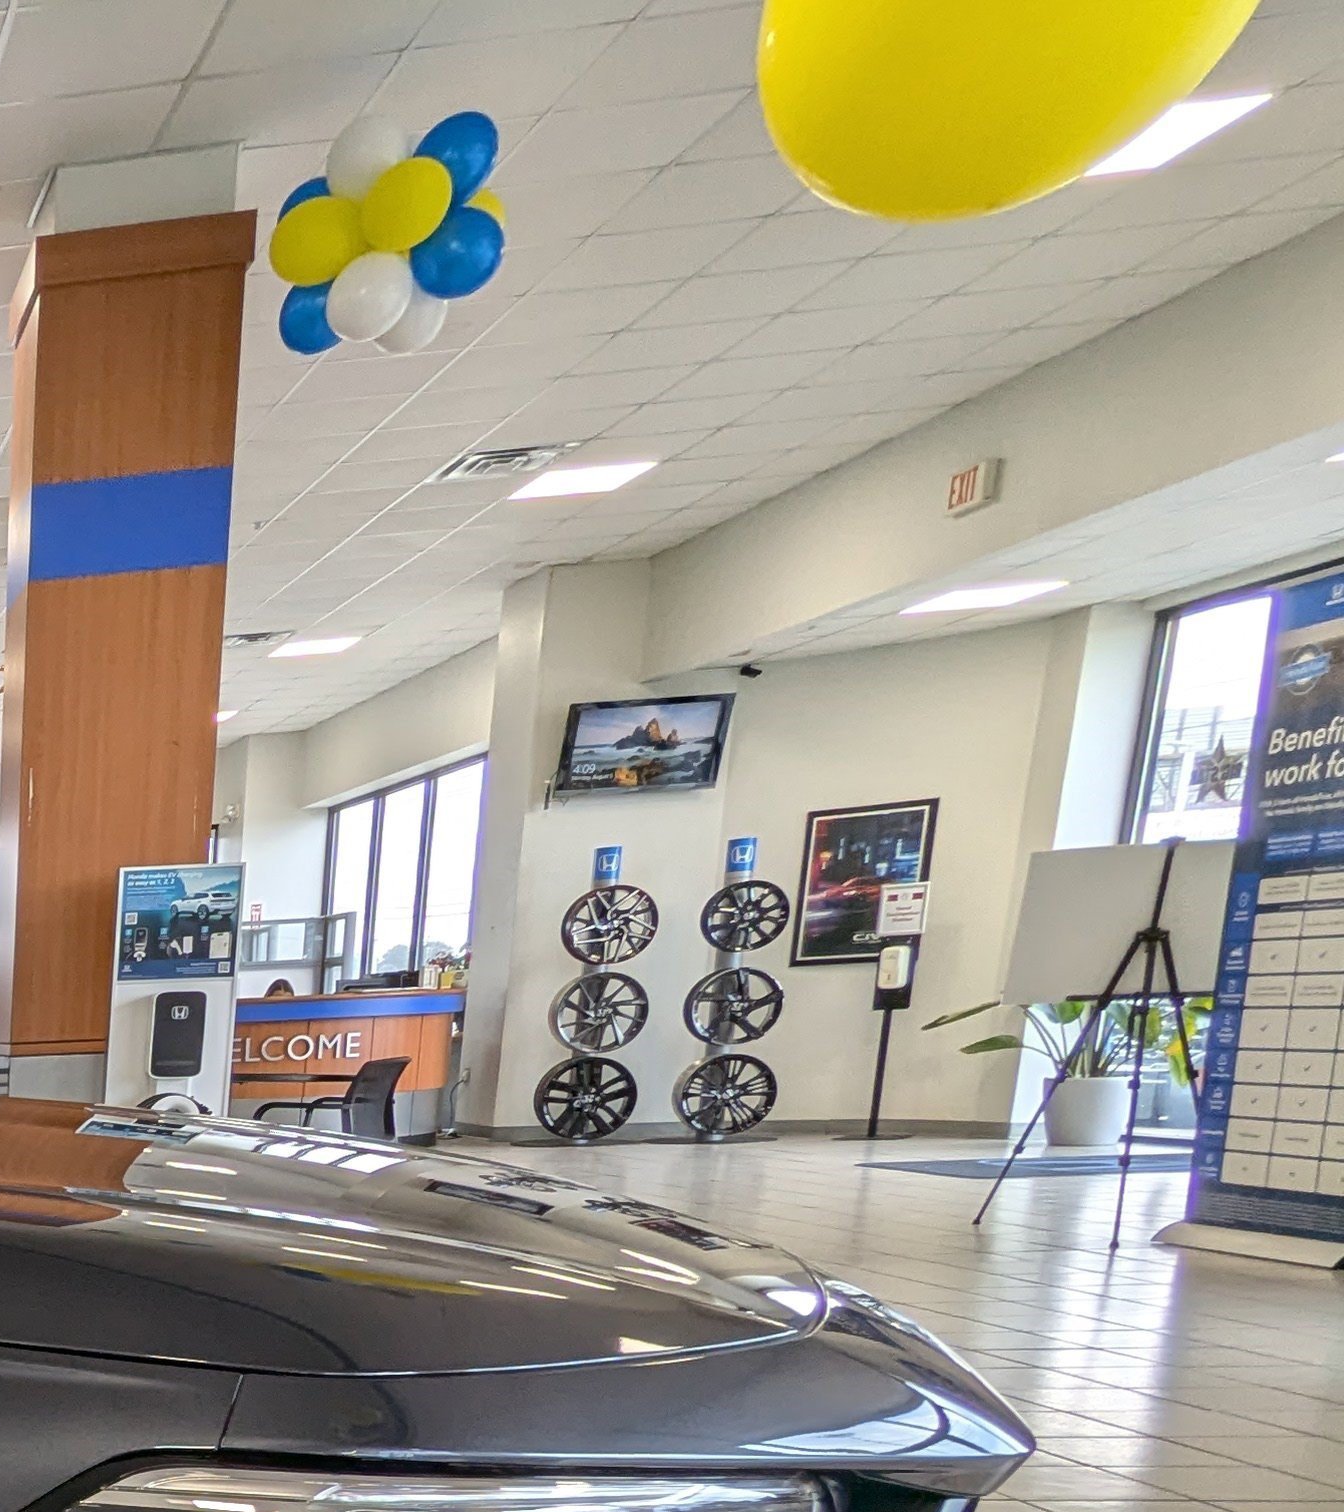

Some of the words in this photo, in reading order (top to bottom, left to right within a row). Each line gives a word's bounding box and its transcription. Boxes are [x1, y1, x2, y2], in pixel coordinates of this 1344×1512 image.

[948, 465, 979, 510] EXIT
[1268, 715, 1344, 755] Benefi
[1264, 753, 1323, 787] work
[231, 1032, 362, 1063] ELCOME
